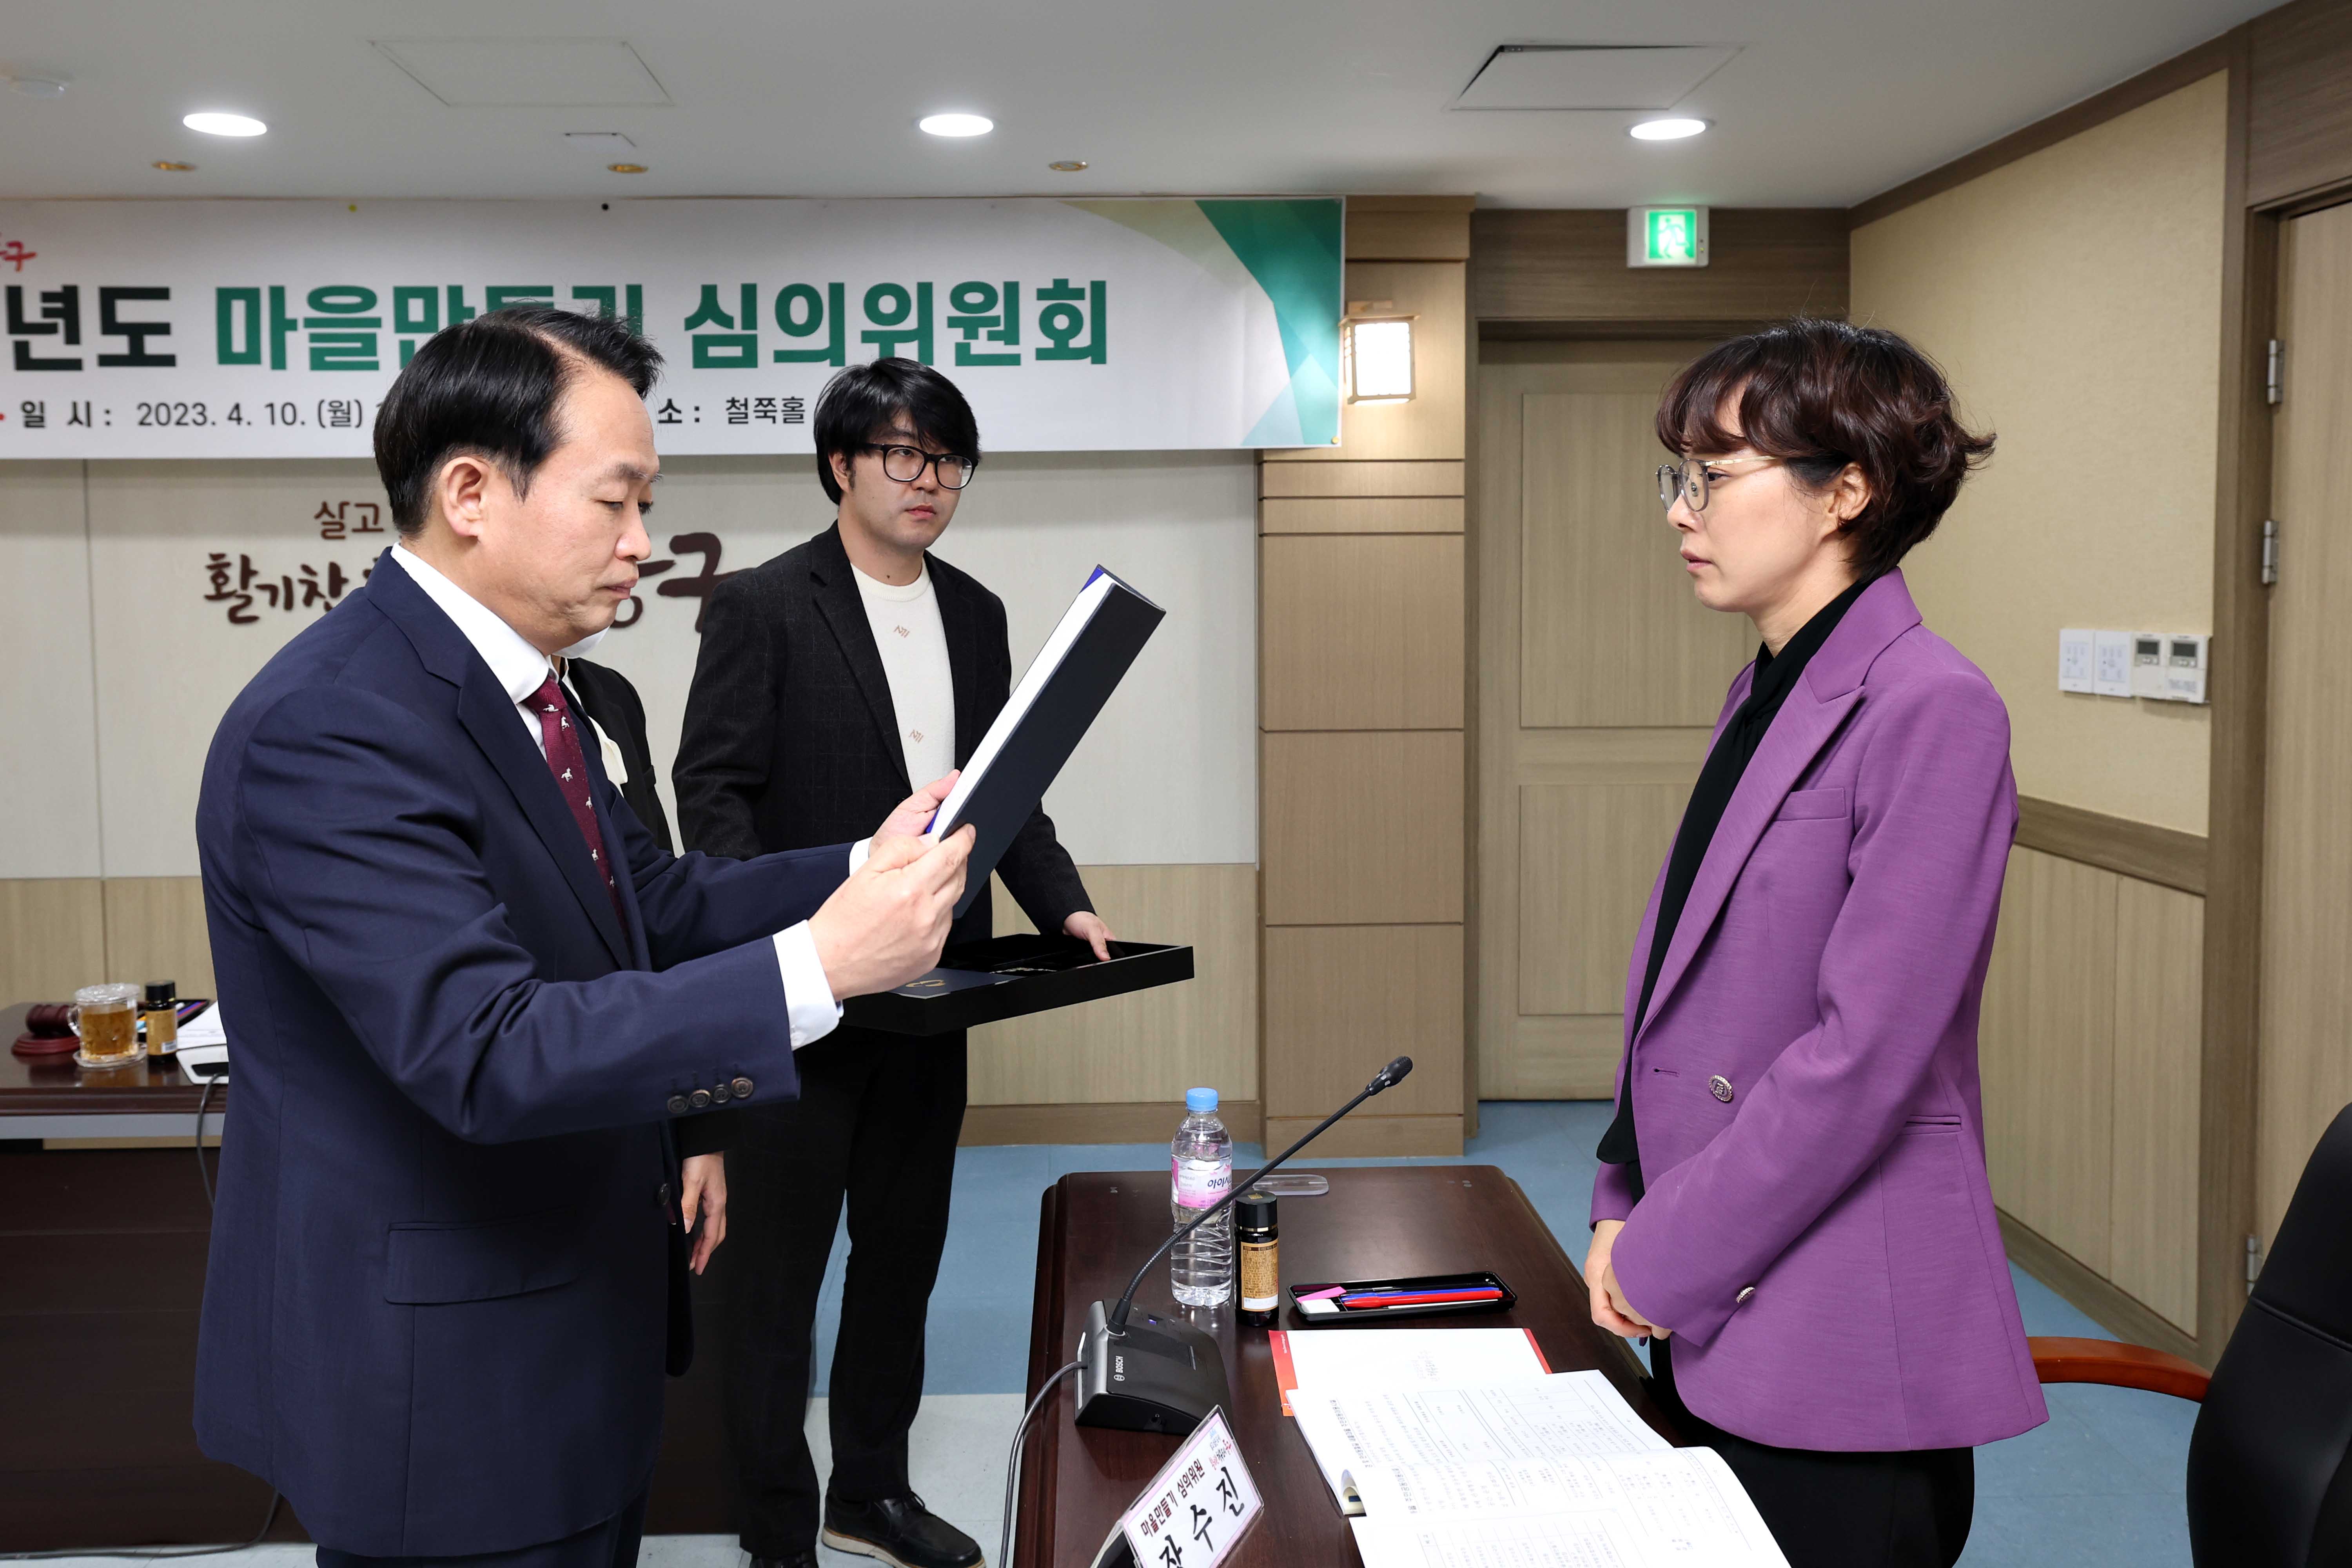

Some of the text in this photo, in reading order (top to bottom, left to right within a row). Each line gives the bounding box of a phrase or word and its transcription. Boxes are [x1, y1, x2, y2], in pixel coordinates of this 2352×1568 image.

[684, 278, 1107, 368] 심의위원회
[318, 399, 362, 428] (월)
[725, 396, 806, 424] 철쭉홀
[314, 501, 384, 540] 살고
[1115, 1356, 1123, 1373] BOSCH
[1140, 1459, 1205, 1538] 마을만들기 심의위원
